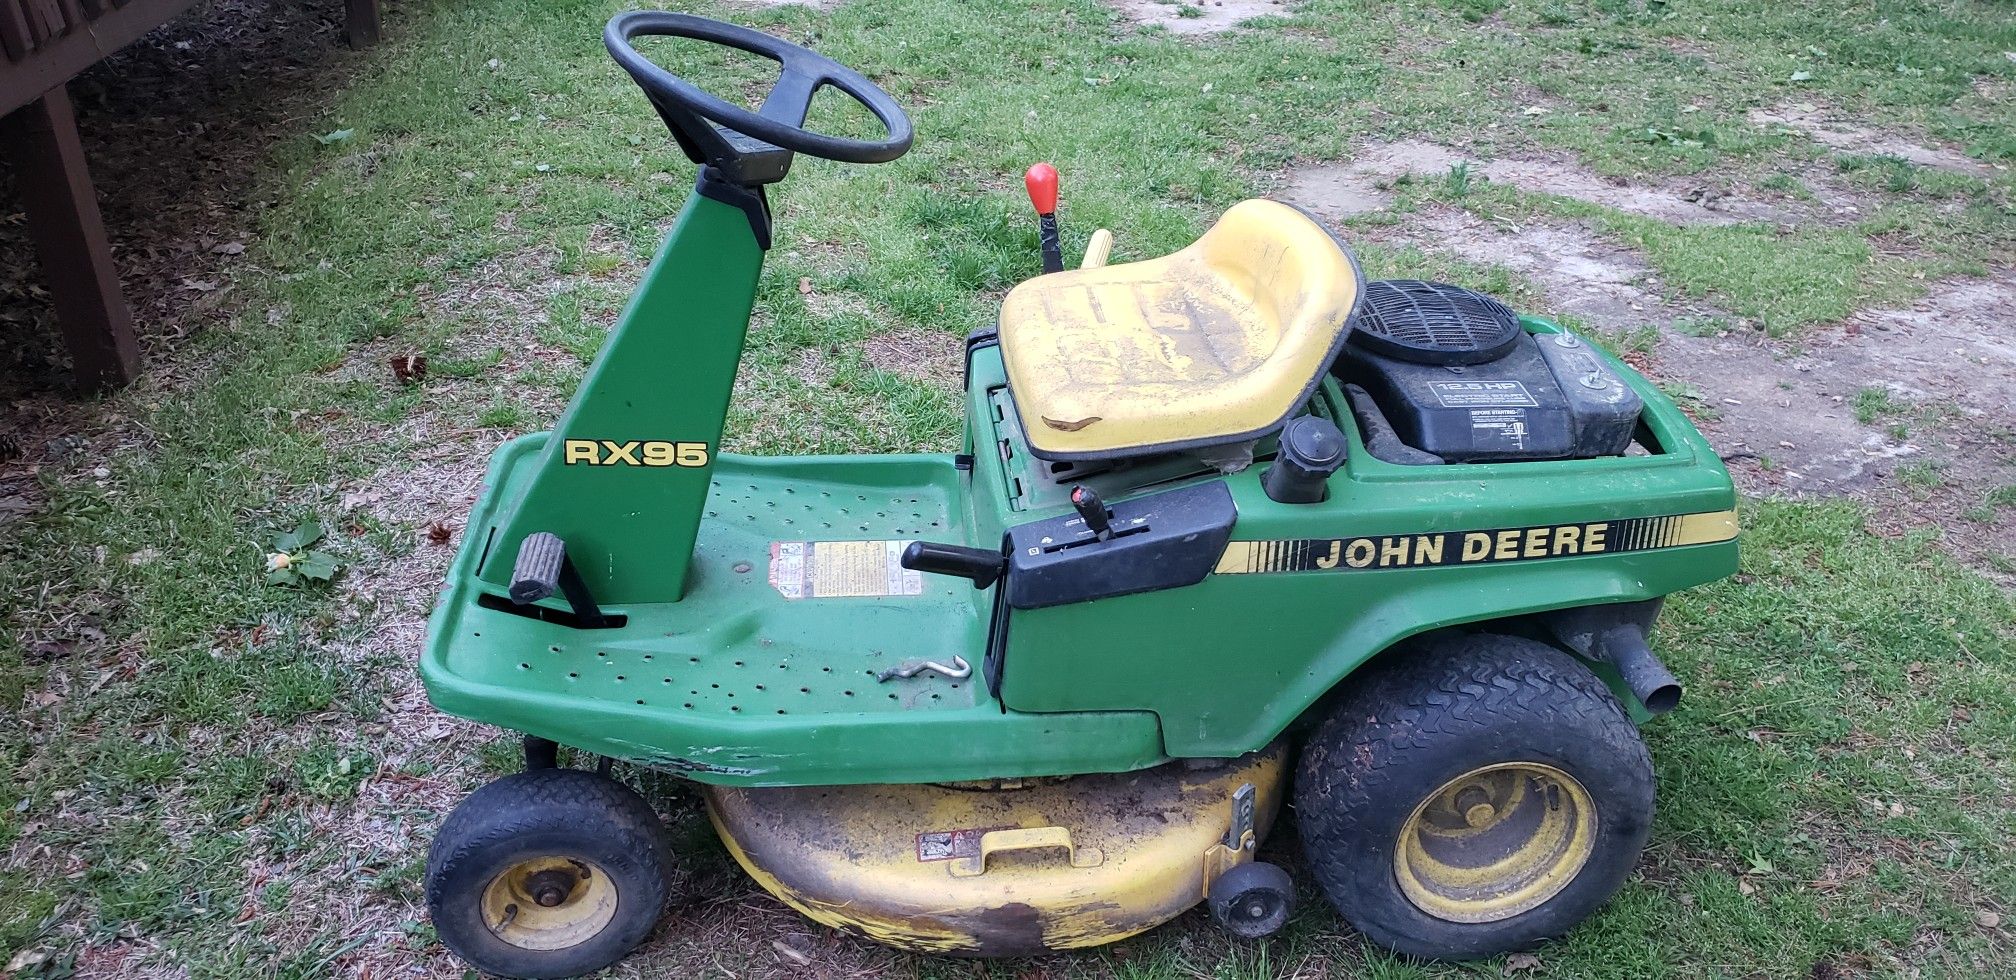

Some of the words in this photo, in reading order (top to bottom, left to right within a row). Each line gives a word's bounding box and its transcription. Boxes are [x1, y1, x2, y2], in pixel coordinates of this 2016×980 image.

[564, 439, 709, 467] RX95
[1316, 535, 1445, 569] JOHN
[1461, 523, 1608, 562] DEERE
